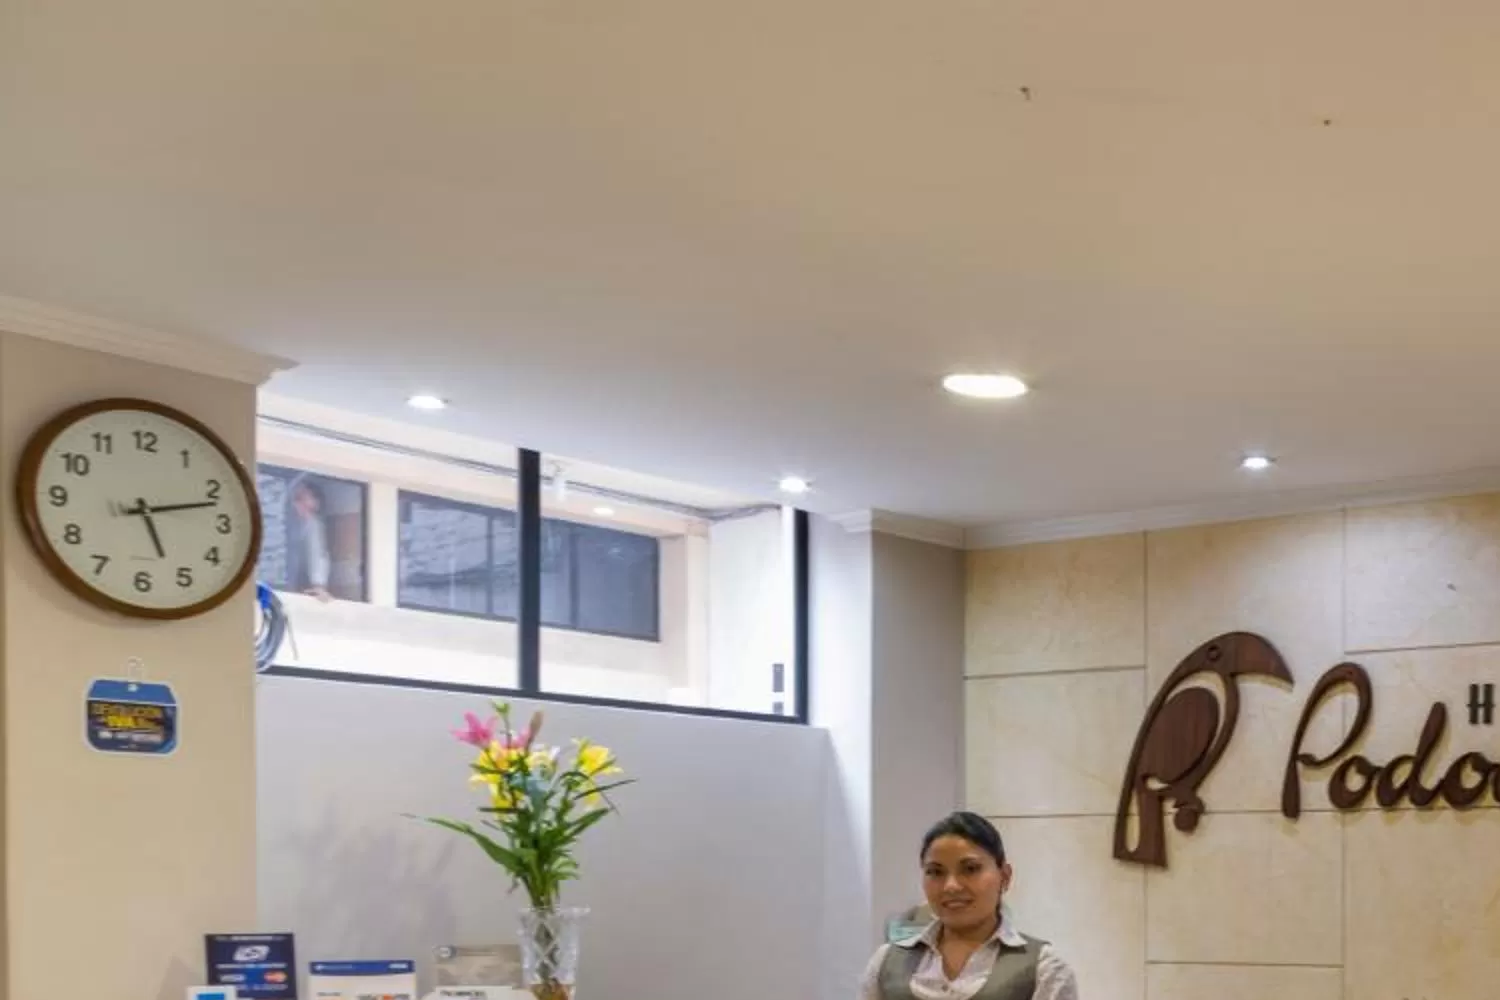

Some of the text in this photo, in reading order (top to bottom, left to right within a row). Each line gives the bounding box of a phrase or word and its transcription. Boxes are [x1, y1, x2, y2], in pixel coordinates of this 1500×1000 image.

[92, 432, 112, 454] 11
[132, 430, 158, 453] 12
[61, 452, 90, 476] 10
[180, 449, 189, 468] 1
[48, 485, 68, 506] 9
[206, 479, 221, 499] 2
[63, 523, 82, 544] 8
[216, 514, 231, 535] 3
[90, 554, 110, 575] 7
[204, 546, 220, 565] 4
[134, 572, 152, 592] 6
[176, 567, 192, 587] 5
